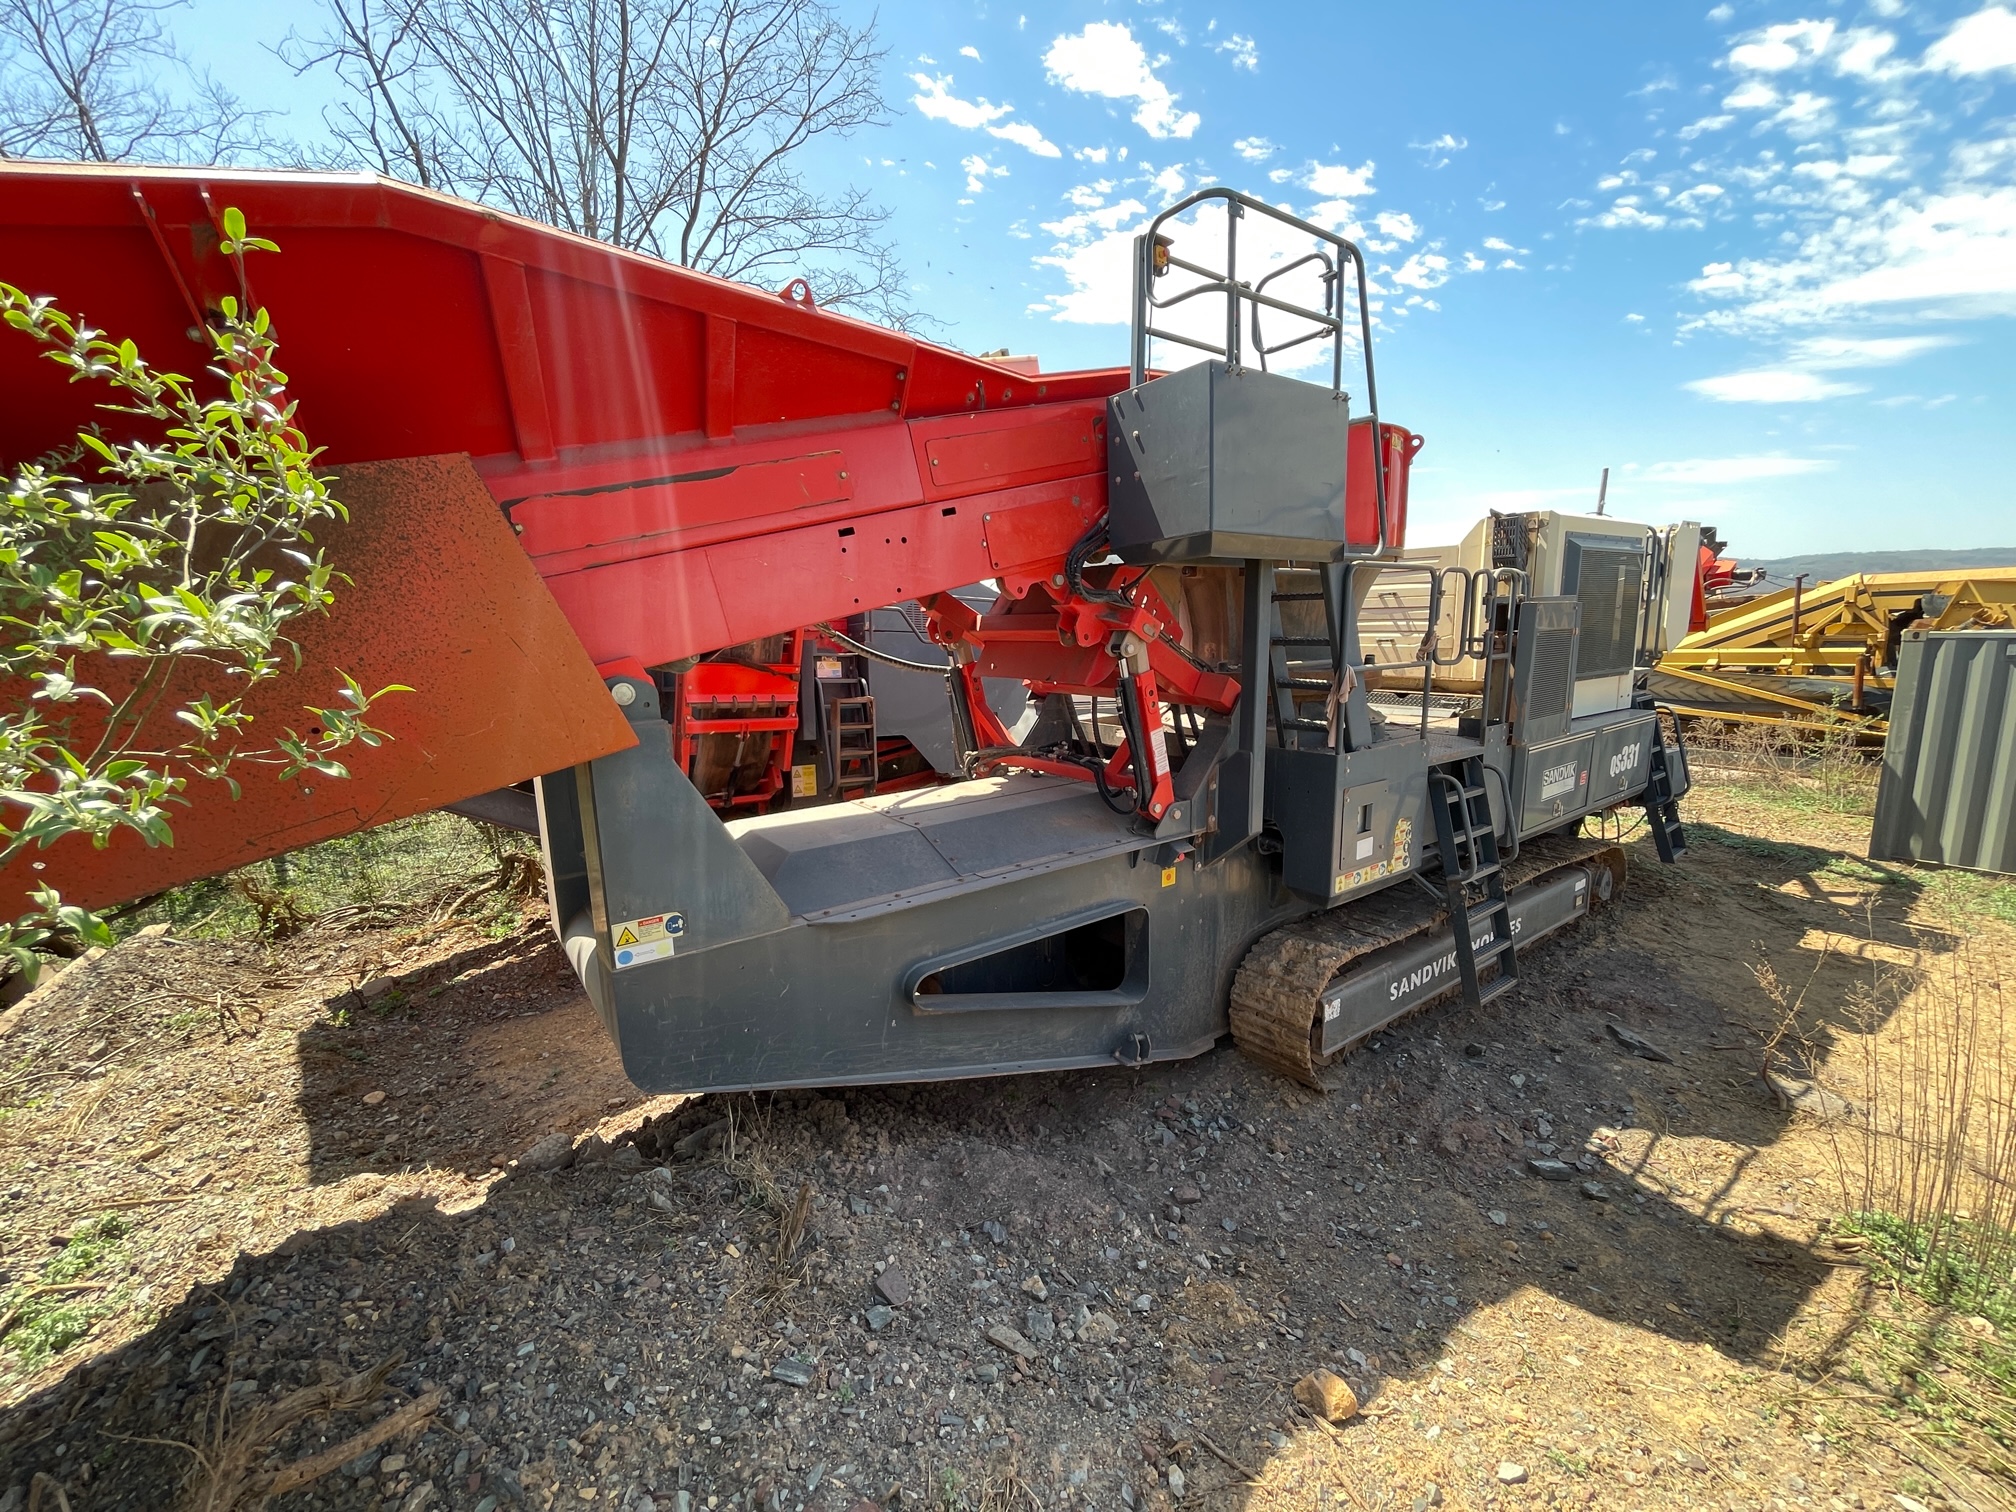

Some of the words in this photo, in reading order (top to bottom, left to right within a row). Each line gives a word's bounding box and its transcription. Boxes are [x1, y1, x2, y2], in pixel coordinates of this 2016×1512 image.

[1543, 763, 1576, 786] SANDVIK
[1609, 742, 1640, 777] QS331
[1389, 951, 1458, 1001] SANDVIK
